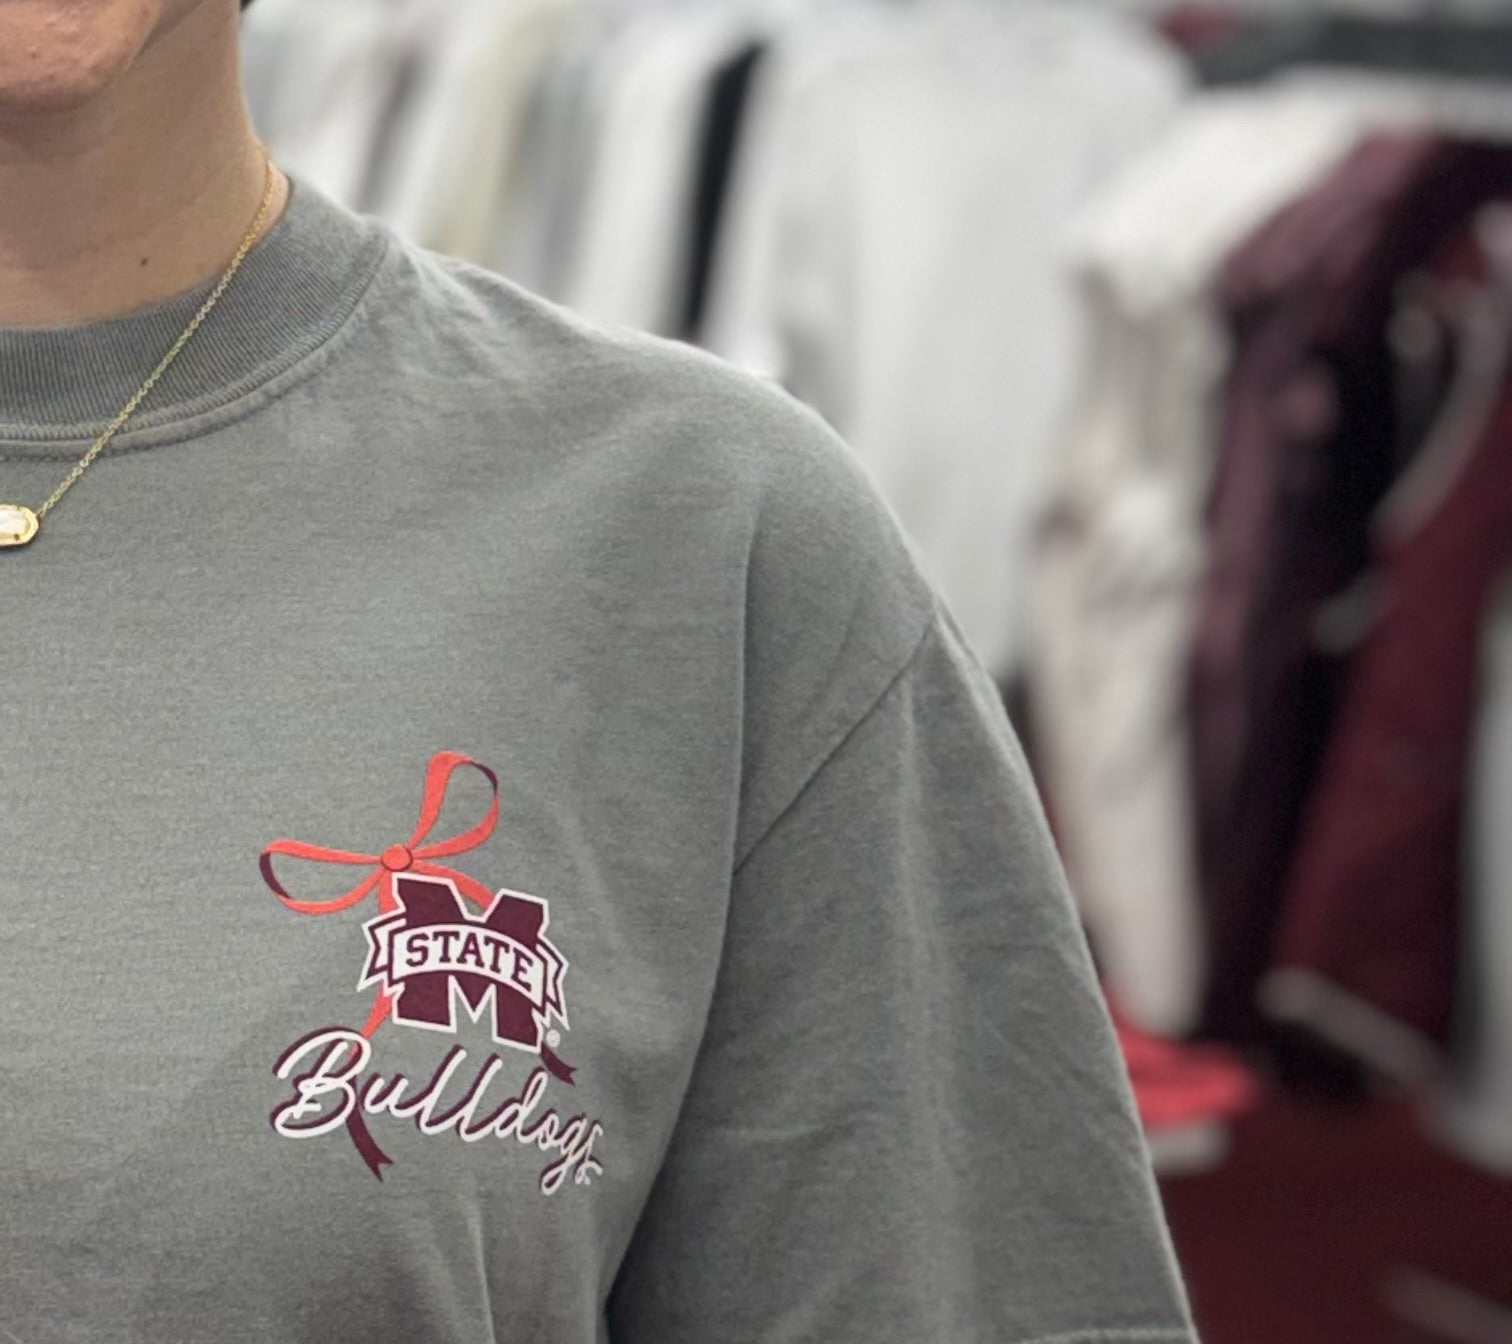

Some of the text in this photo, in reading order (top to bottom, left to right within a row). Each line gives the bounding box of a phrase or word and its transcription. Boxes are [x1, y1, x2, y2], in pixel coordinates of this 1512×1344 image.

[393, 873, 549, 1053] M
[405, 931, 534, 992] STATE
[270, 1026, 604, 1196] Bulldogs
